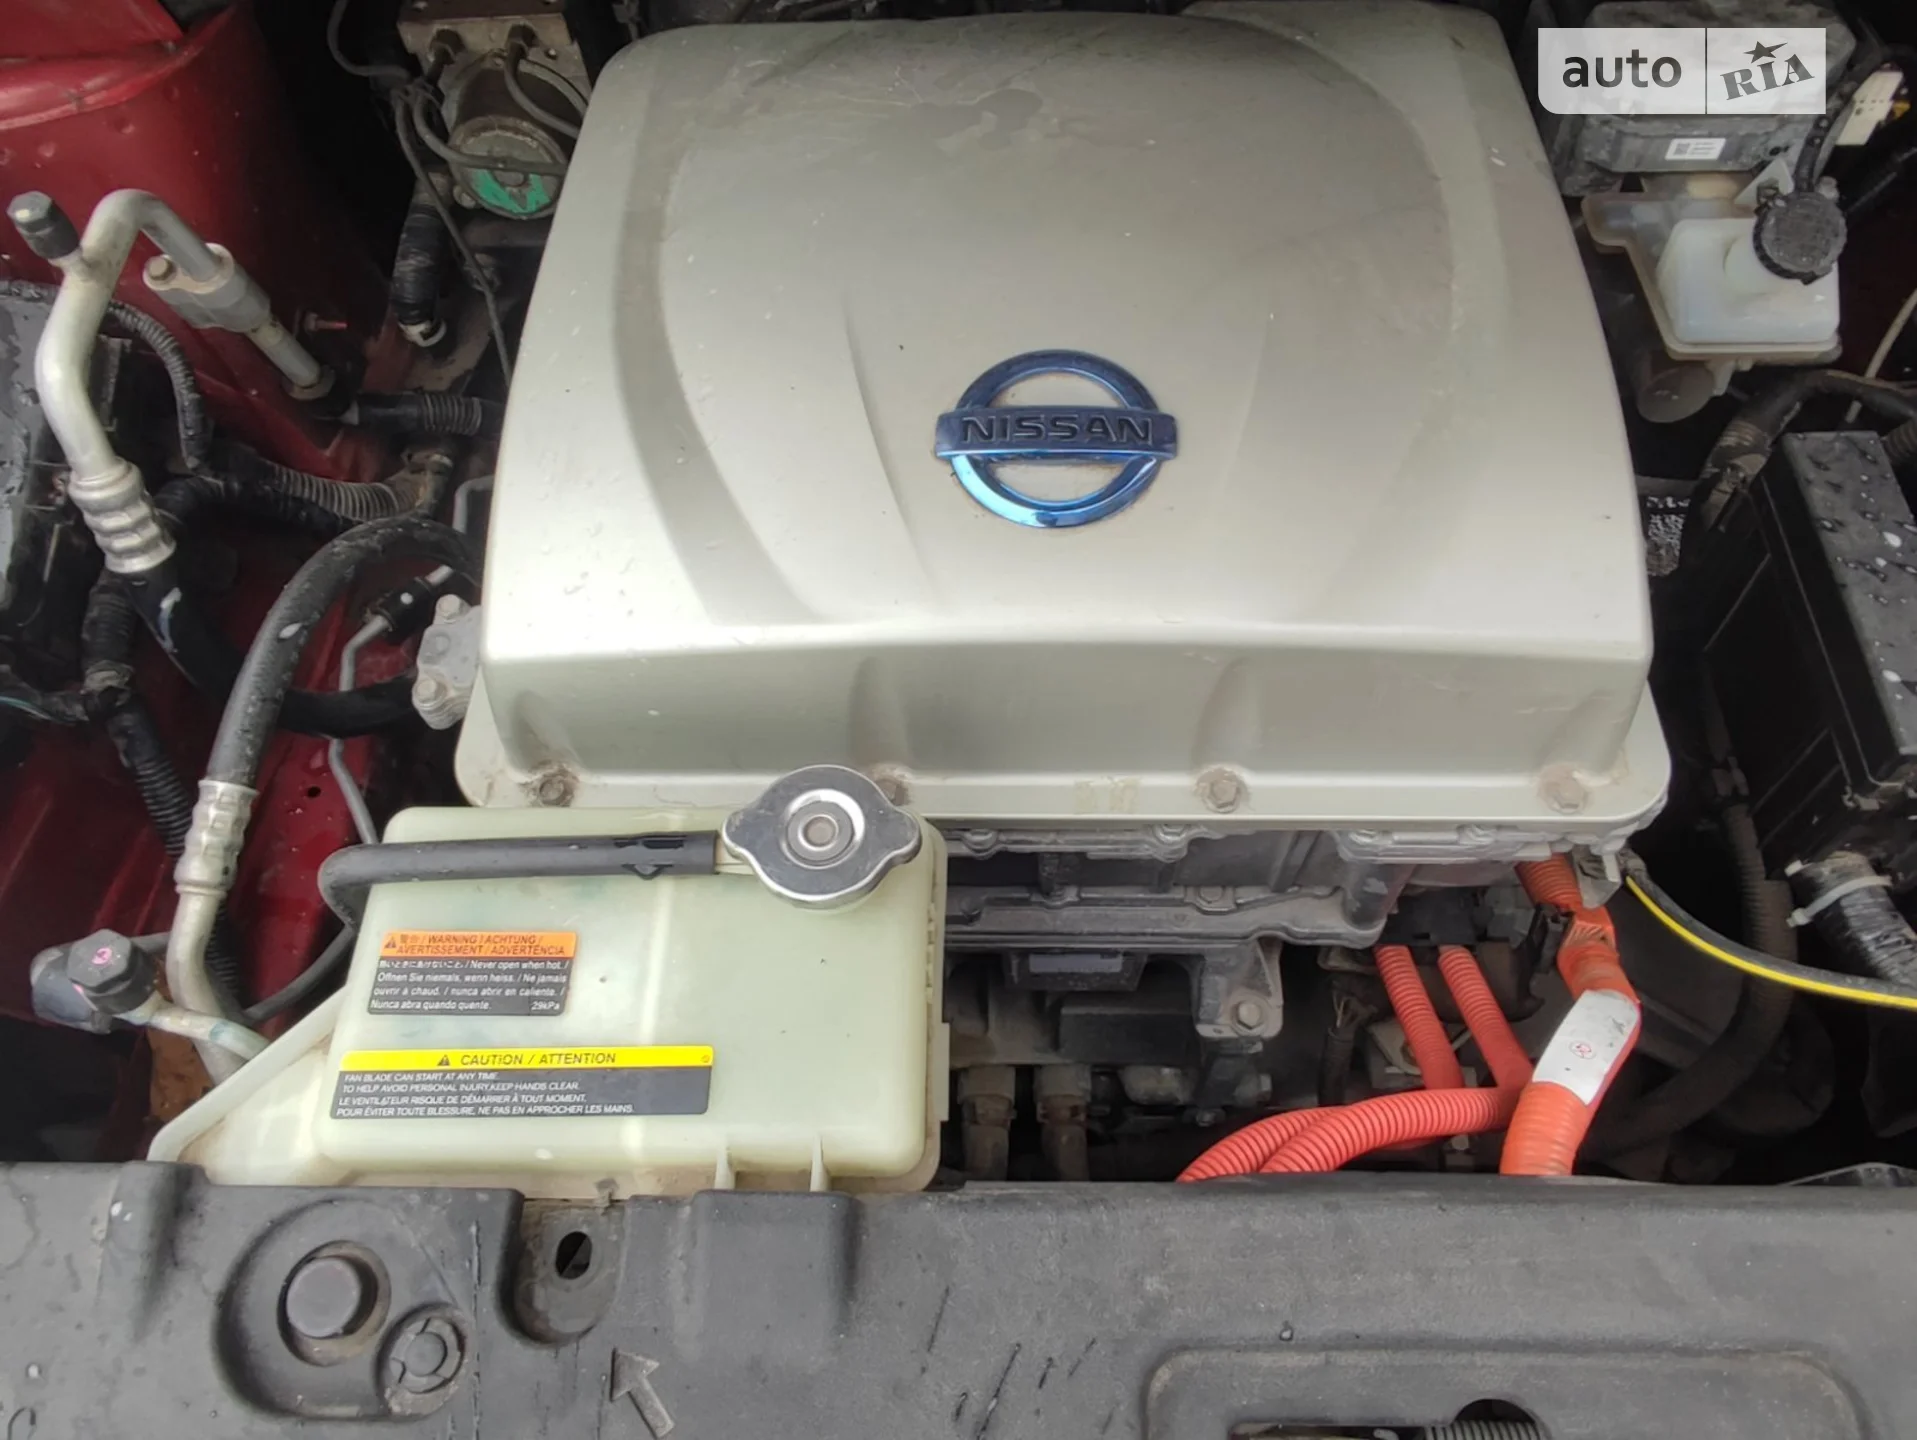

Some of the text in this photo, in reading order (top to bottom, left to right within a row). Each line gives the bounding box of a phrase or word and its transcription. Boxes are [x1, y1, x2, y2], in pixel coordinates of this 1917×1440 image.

[961, 413, 1153, 445] NISSAN
[428, 934, 478, 944] WARNING
[484, 934, 536, 945] ACHTUNG
[396, 945, 483, 955] AVERTISSEMENT
[491, 945, 565, 955] ADVERTENCIA
[470, 960, 497, 969] Never
[498, 962, 520, 971] open
[521, 961, 544, 969] when
[523, 973, 536, 983] Ne
[537, 975, 566, 984] jamais
[504, 988, 517, 996] en
[371, 1000, 399, 1009] Nunca
[400, 1000, 422, 1009] abra
[422, 1001, 456, 1011] quando
[460, 1054, 523, 1066] CAUTION
[538, 1053, 616, 1064] ATTENTION
[345, 1074, 361, 1082] FAN
[363, 1073, 392, 1082] BLADE
[394, 1073, 413, 1081] CAN
[415, 1073, 443, 1081] START
[444, 1072, 455, 1080] AT
[457, 1072, 476, 1080] ANY
[343, 1084, 354, 1093] TO
[356, 1084, 379, 1093] HELP
[381, 1084, 408, 1092] AVOID
[409, 1083, 457, 1092] PERSONAL
[515, 1082, 547, 1091] HANDS
[339, 1097, 350, 1105] LE
[411, 1095, 444, 1105] RISQUE
[446, 1095, 459, 1104] DE
[521, 1094, 544, 1103] TOUT
[336, 1107, 363, 1116] POUR
[397, 1107, 426, 1116] TOUTE
[478, 1106, 491, 1114] NE
[492, 1106, 511, 1114] PAS
[513, 1106, 525, 1114] EN
[526, 1104, 583, 1114] APPROCHER
[585, 1104, 602, 1113] LES
